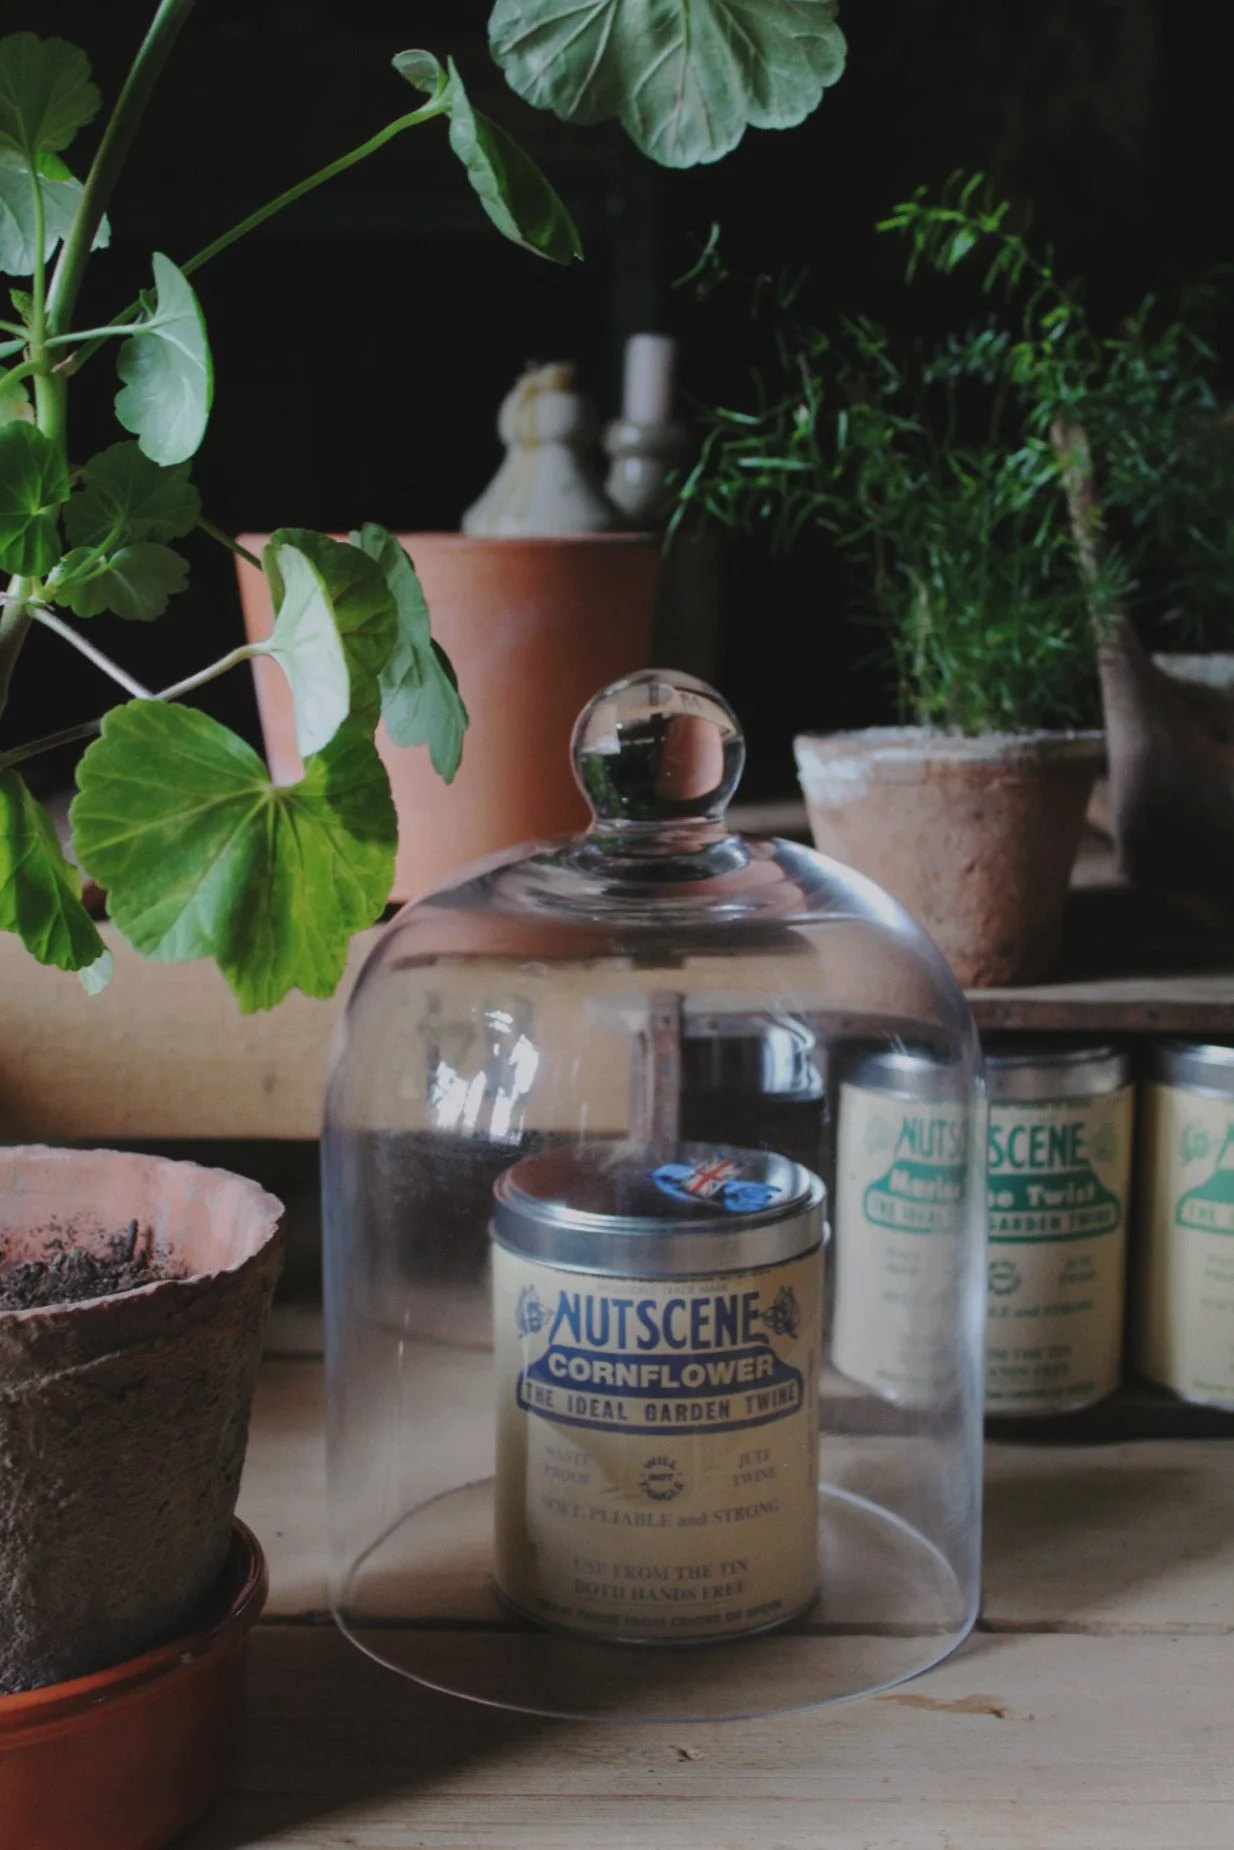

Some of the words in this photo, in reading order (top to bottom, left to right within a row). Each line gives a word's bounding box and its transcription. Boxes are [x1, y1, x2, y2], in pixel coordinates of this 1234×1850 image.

[1026, 1180, 1095, 1208] Twist
[549, 1290, 768, 1351] NUTSCENE
[548, 1353, 774, 1388] CORNFLOWER
[525, 1381, 554, 1409] THE
[567, 1399, 628, 1421] IDEAL
[644, 1400, 731, 1422] GARDEN
[745, 1382, 796, 1415] TWINE
[737, 1448, 770, 1469] JUTE
[732, 1466, 777, 1488] TWINE
[590, 1505, 672, 1528] PLIABLE
[677, 1512, 707, 1528] and
[712, 1499, 780, 1524] STRONG
[611, 1562, 669, 1581] FROM
[675, 1564, 712, 1581] THE
[720, 1559, 748, 1577] TIN
[631, 1586, 697, 1602] HANDS
[702, 1580, 745, 1600] FREE
